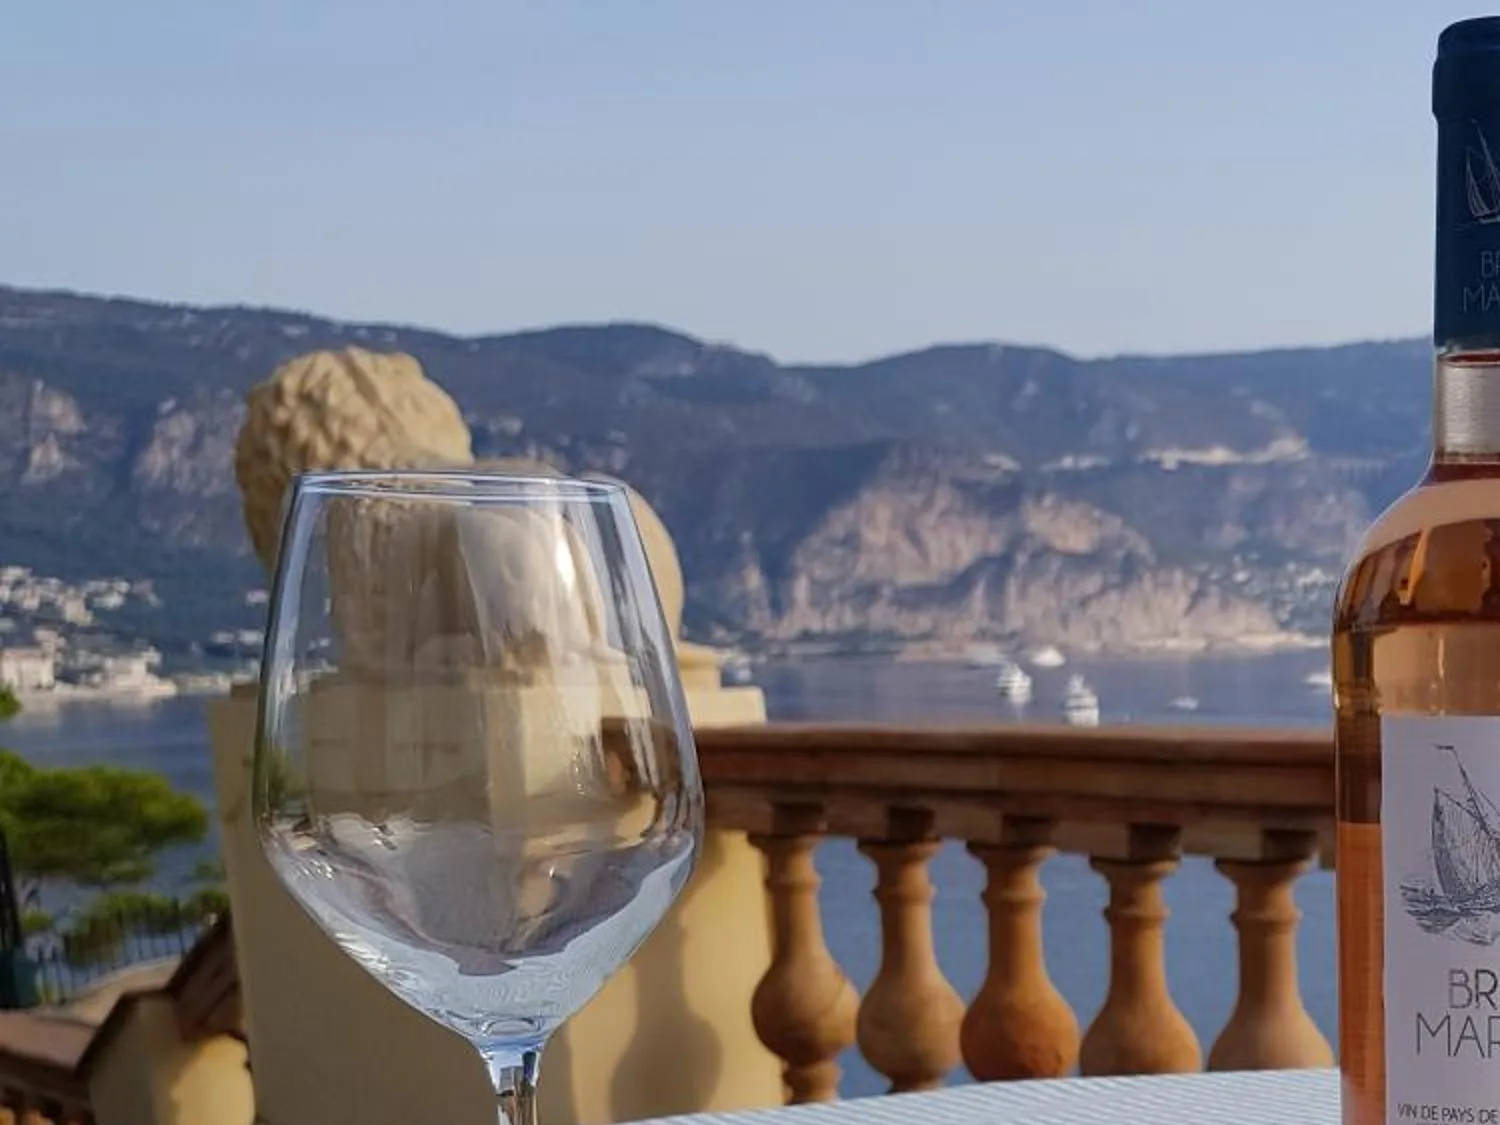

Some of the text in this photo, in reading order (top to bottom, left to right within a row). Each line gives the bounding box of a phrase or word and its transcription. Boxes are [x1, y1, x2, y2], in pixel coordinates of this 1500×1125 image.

[1398, 1103, 1417, 1118] VIN
[1421, 1105, 1439, 1121] DE
[1442, 1107, 1475, 1123] PAYS
[1479, 1108, 1499, 1125] DE
